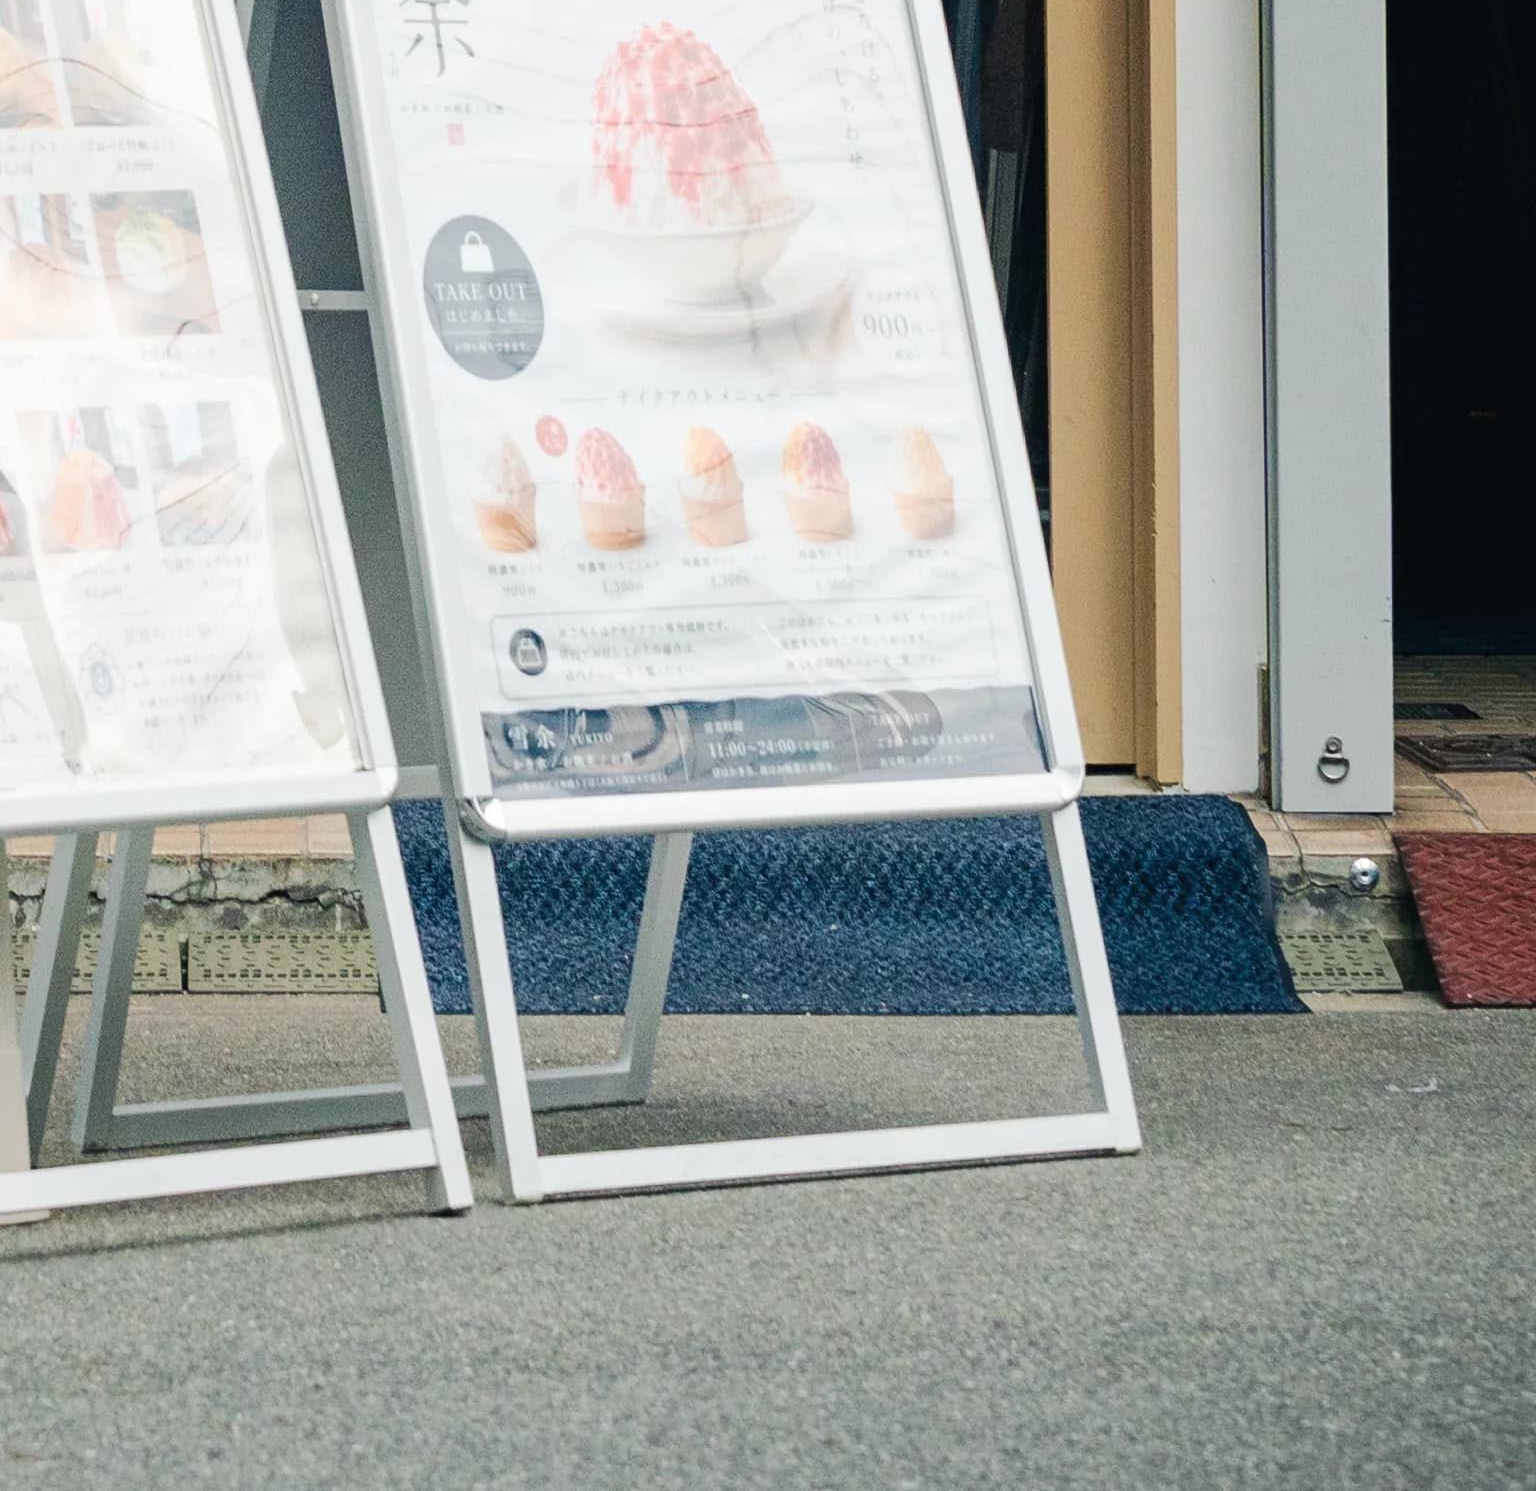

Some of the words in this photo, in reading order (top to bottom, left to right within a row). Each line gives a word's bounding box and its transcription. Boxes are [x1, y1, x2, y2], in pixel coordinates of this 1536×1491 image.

[433, 282, 482, 301] TAKE
[488, 282, 529, 301] OUT
[568, 731, 614, 746] YUKIYO
